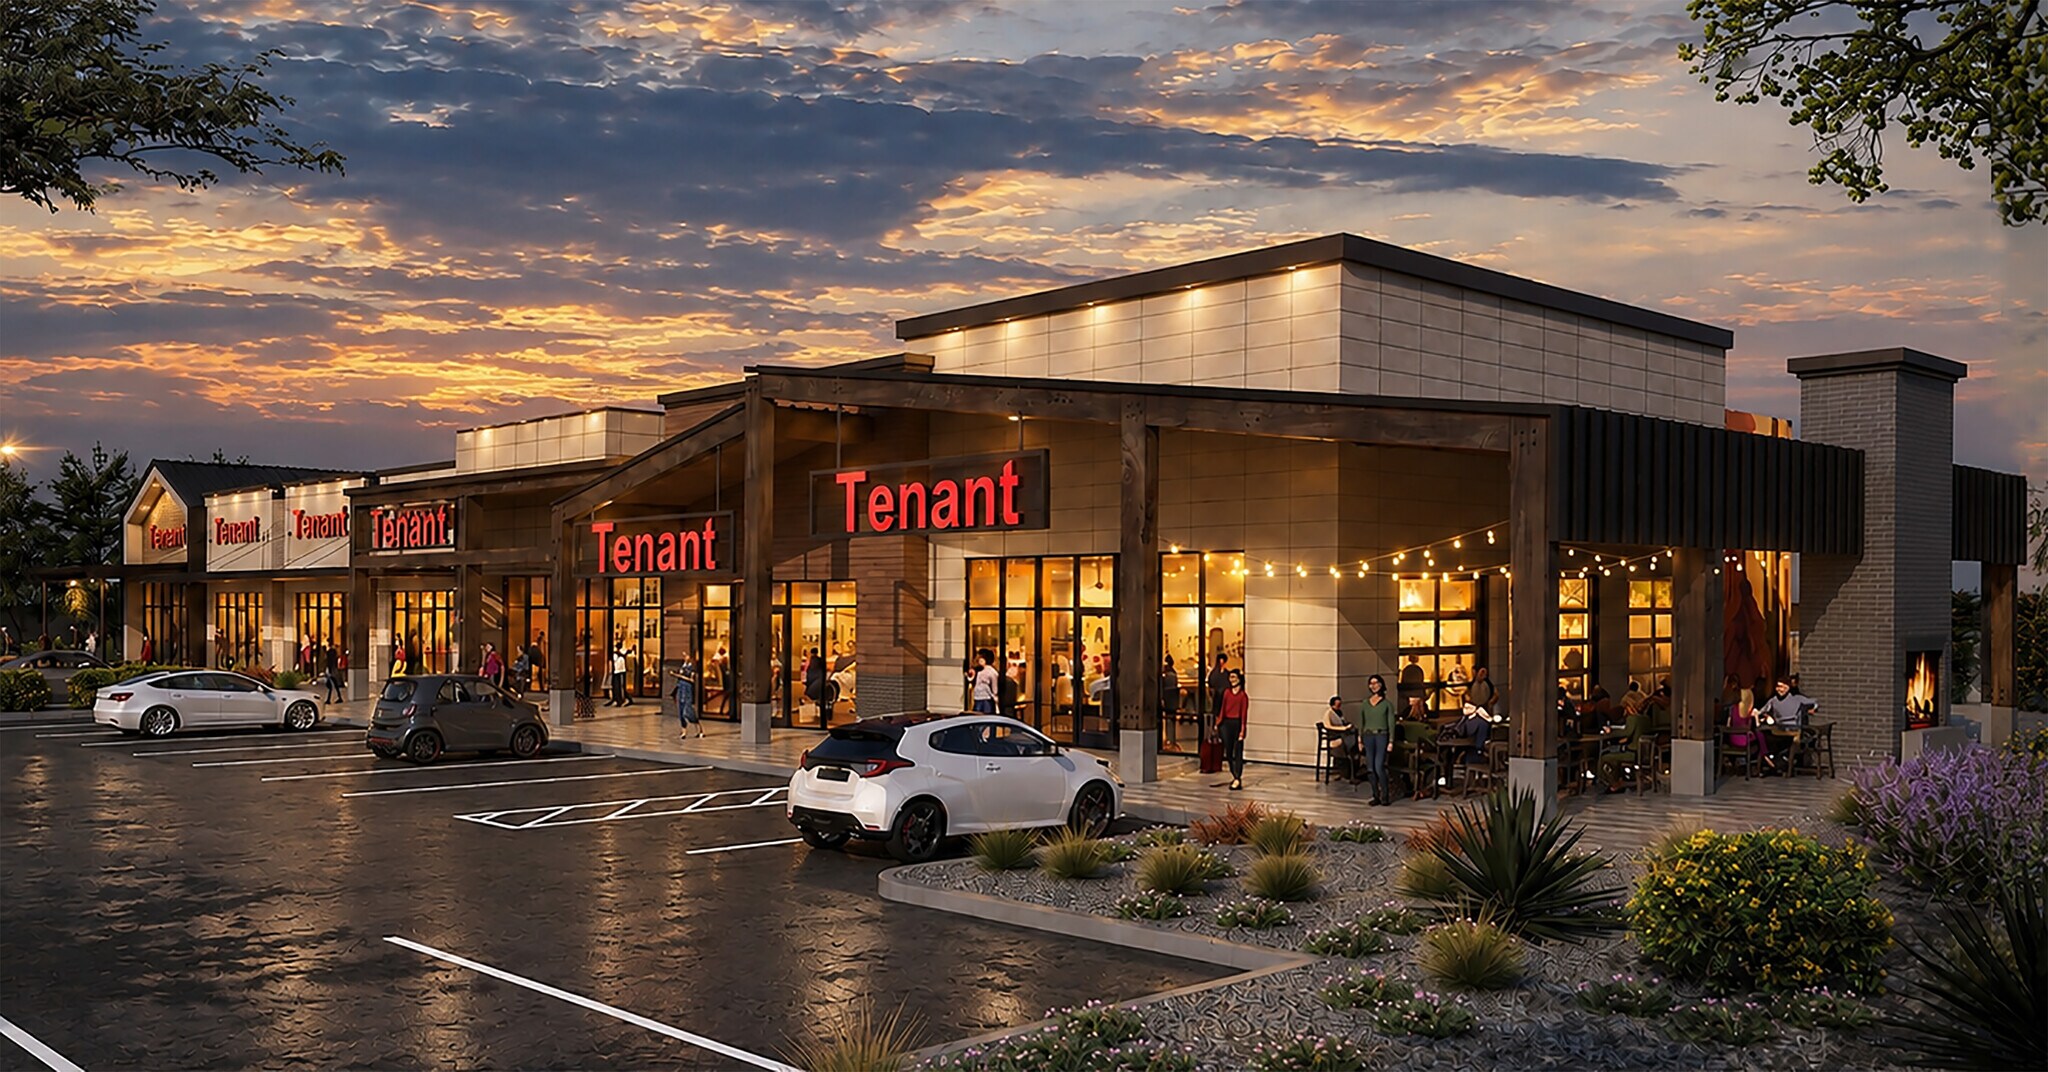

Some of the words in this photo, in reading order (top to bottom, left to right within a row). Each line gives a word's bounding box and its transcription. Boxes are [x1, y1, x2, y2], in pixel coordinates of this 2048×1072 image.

[836, 460, 1020, 533] Tenant
[292, 508, 349, 540] Tenant
[371, 505, 446, 548] Tenant
[592, 518, 716, 573] Tenant
